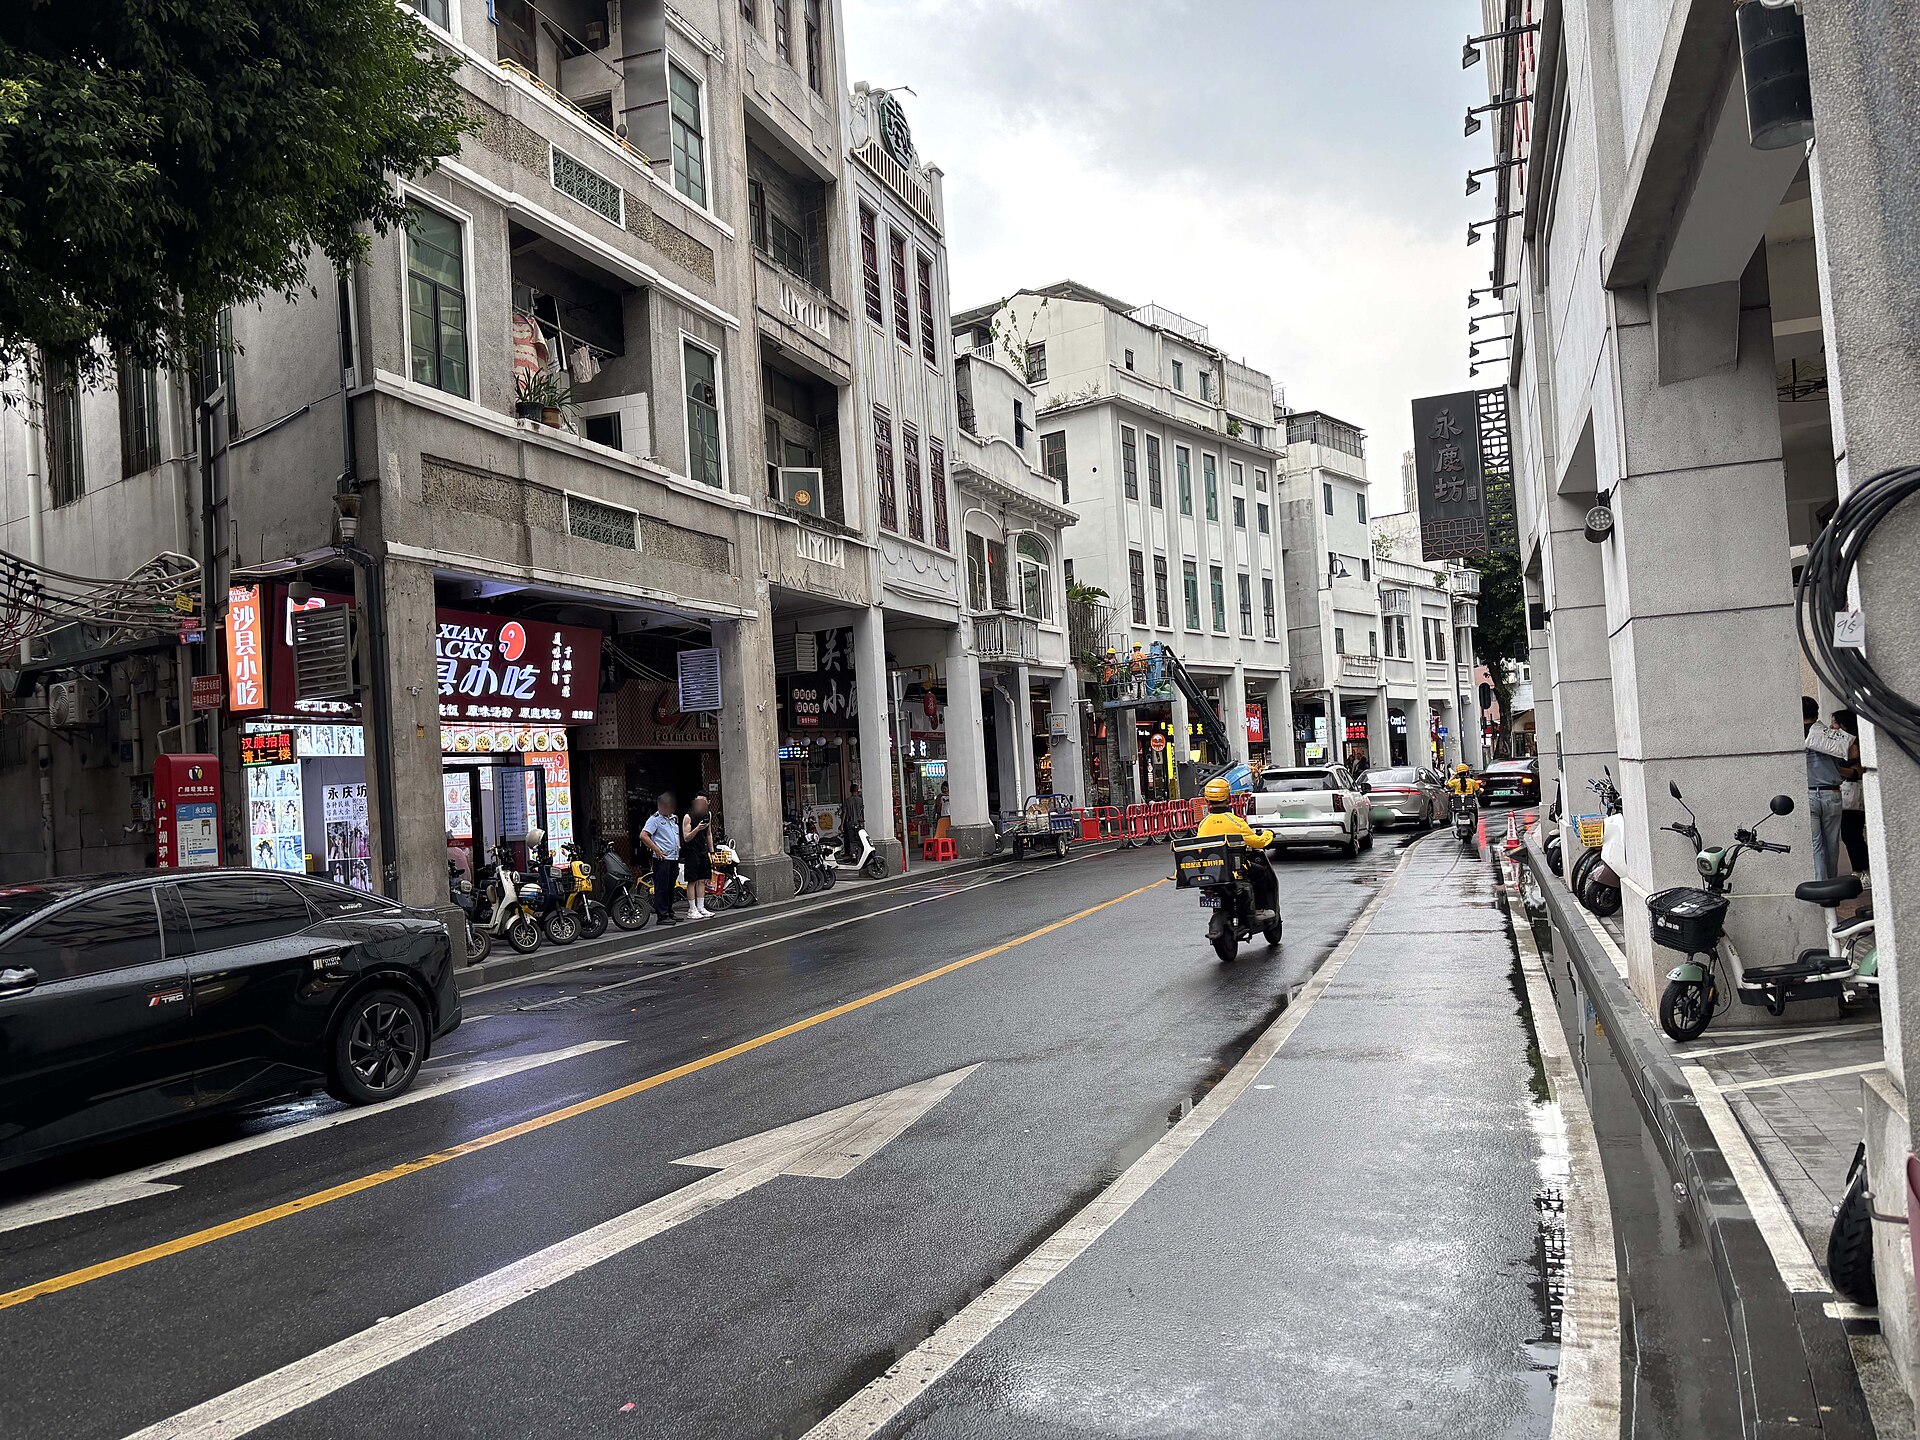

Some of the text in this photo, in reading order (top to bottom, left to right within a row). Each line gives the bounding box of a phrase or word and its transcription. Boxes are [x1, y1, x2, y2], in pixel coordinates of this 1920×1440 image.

[232, 605, 259, 706] 沙县小吃
[241, 734, 291, 750] 汉服拍照
[242, 747, 291, 763] 请上二楼
[328, 785, 367, 800] 永庆坊
[323, 956, 341, 964] TOYOTA
[161, 994, 184, 1004] TRD
